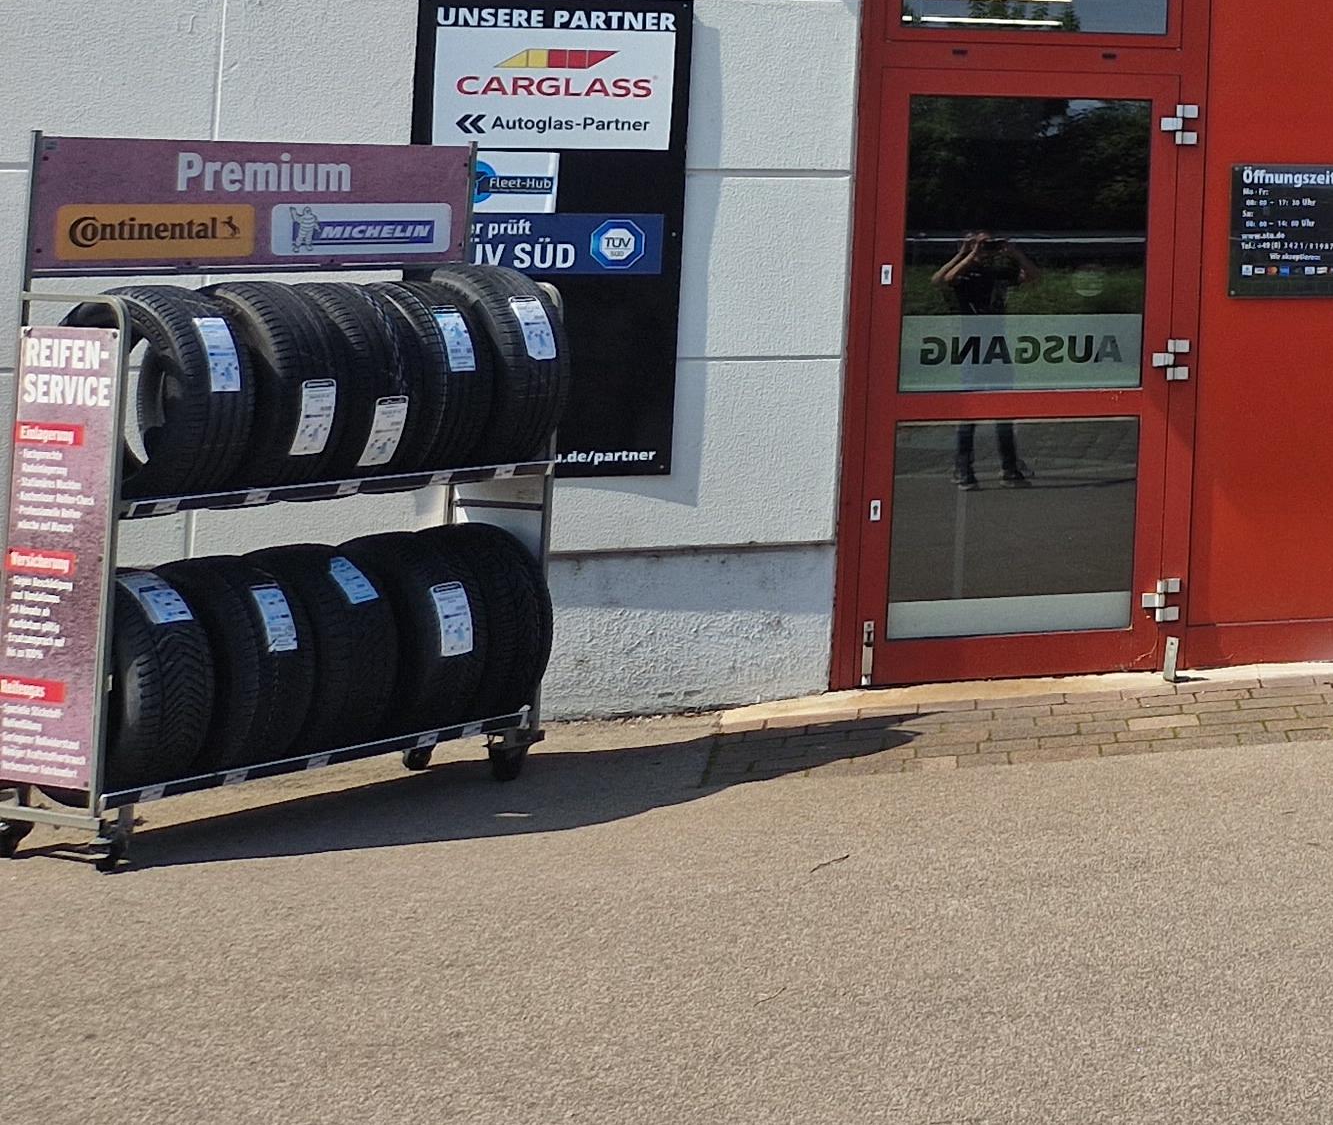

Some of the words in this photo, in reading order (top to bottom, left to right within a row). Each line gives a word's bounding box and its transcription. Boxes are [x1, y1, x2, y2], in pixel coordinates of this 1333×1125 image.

[437, 6, 544, 27] UNSERE
[554, 9, 677, 31] PARTNER
[491, 116, 650, 133] Autoglas-Partner
[175, 152, 351, 192] Premium
[489, 177, 552, 189] Fleet-Hub
[1302, 198, 1316, 206] Uhr
[69, 216, 218, 248] Continental
[319, 223, 434, 239] MICHELIN
[488, 219, 531, 239] prüft
[1301, 219, 1316, 227] Uhr
[605, 236, 631, 248] TÜV
[513, 237, 575, 269] SÜD
[25, 338, 109, 369] REIFEN-
[23, 373, 111, 406] SERVICE
